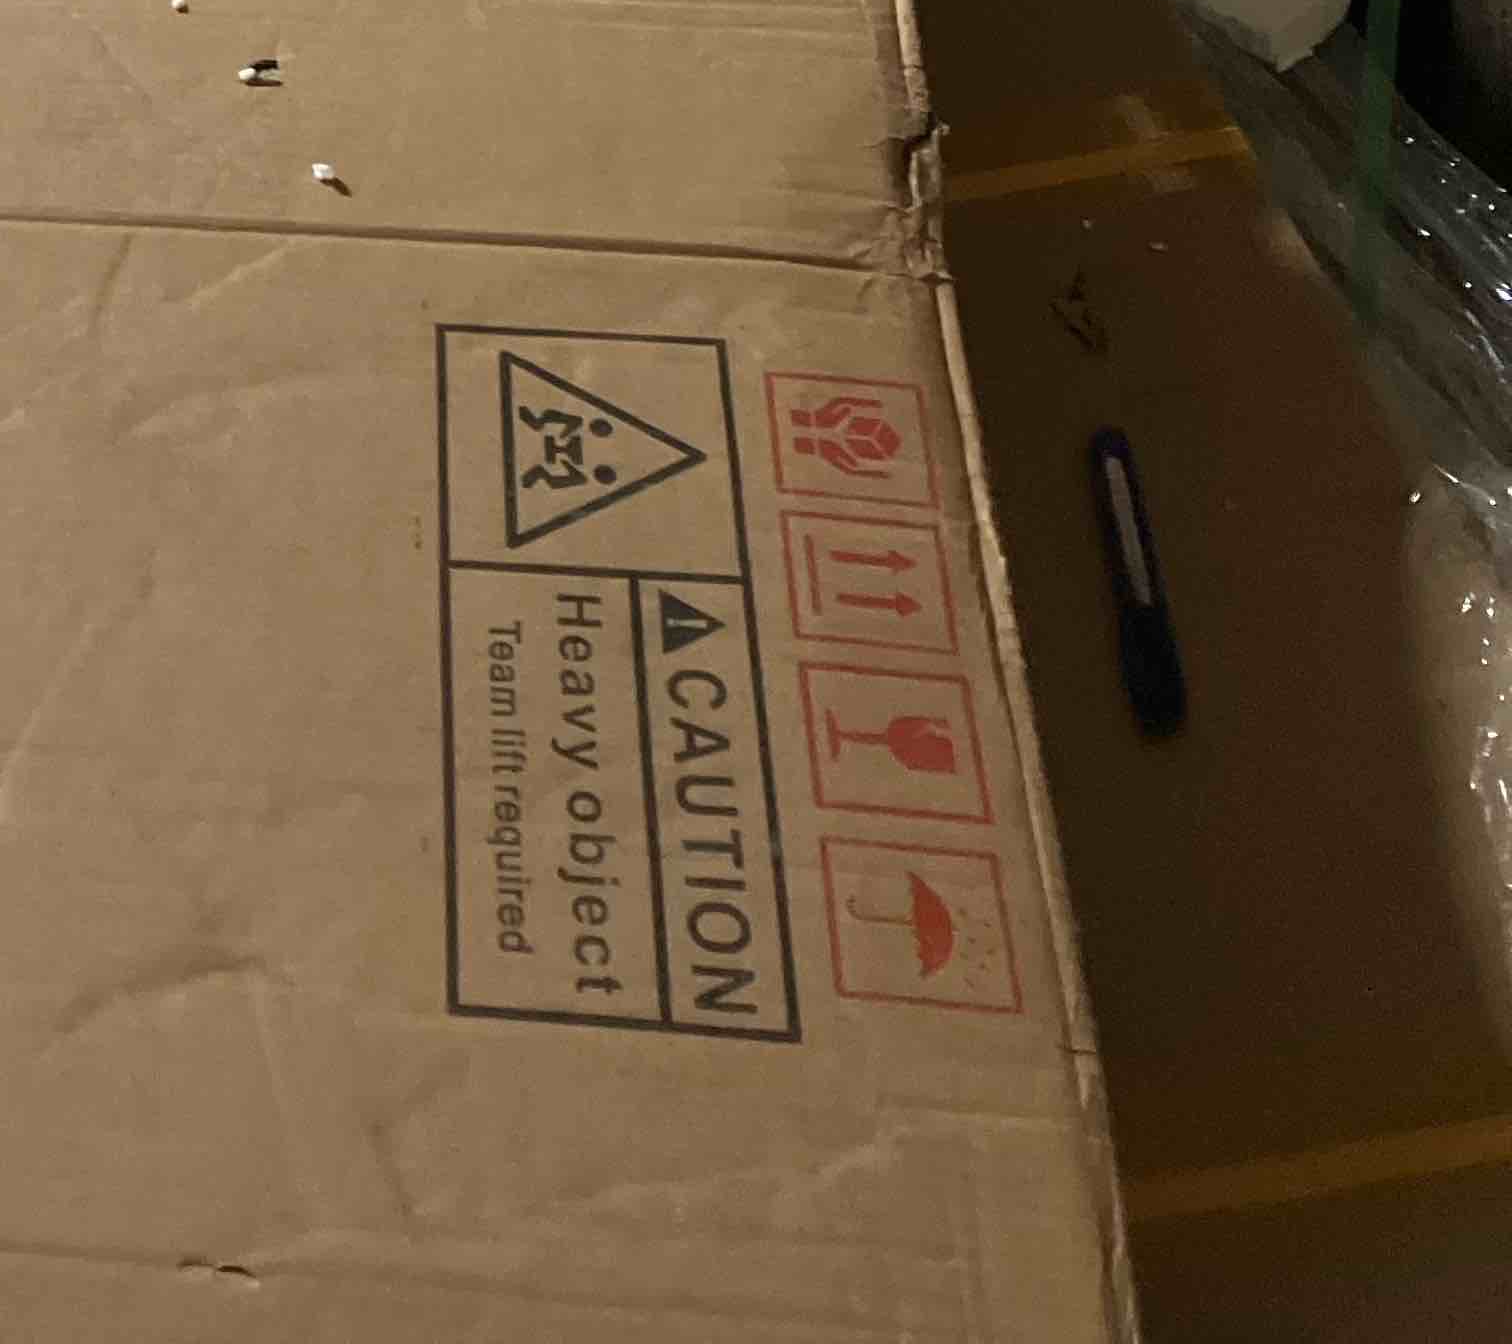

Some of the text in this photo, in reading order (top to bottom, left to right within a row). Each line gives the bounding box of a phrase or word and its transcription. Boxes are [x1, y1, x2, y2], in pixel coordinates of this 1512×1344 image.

[488, 620, 535, 954] Team lift required
[551, 592, 624, 995] Heavy object
[664, 668, 759, 1016] CAUTION
